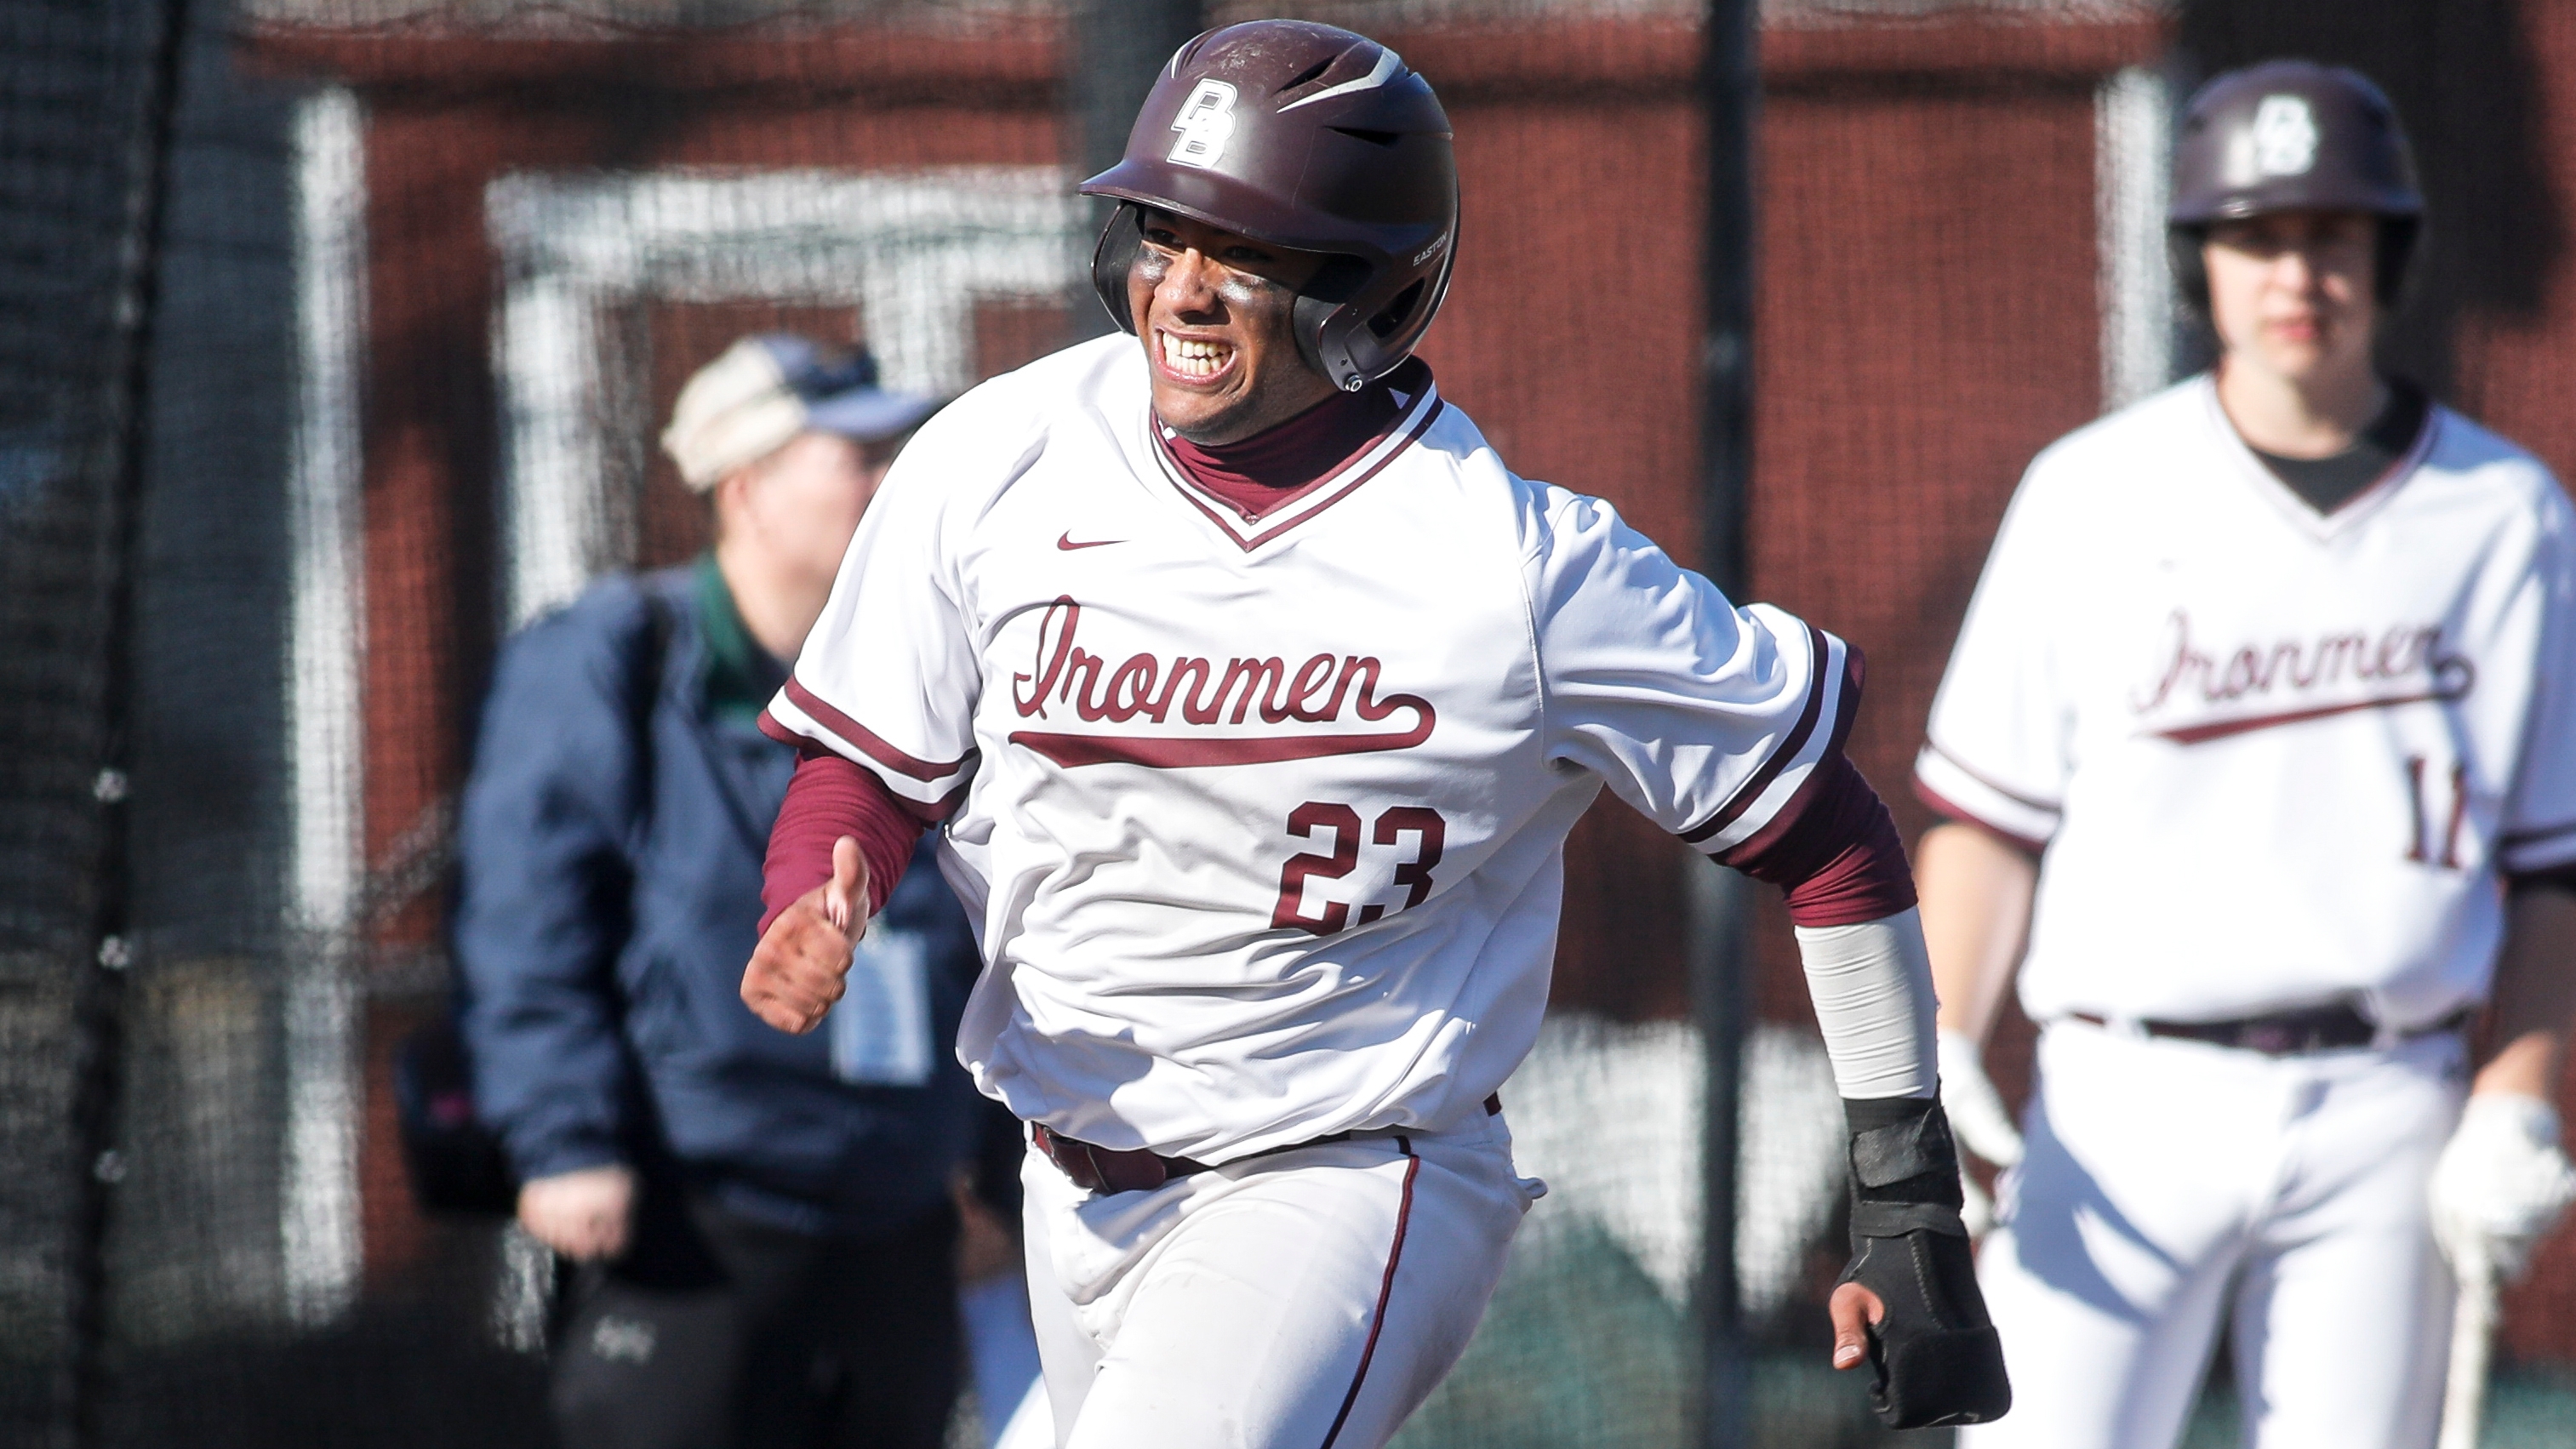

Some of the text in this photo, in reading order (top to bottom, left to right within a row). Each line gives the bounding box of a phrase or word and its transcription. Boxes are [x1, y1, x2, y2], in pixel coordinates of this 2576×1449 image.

[1413, 231, 1447, 266] EASTON
[1012, 594, 1437, 726] Ironmen
[2129, 604, 2476, 715] Ironmen
[1270, 801, 1446, 937] 23
[2404, 754, 2467, 869] 11
